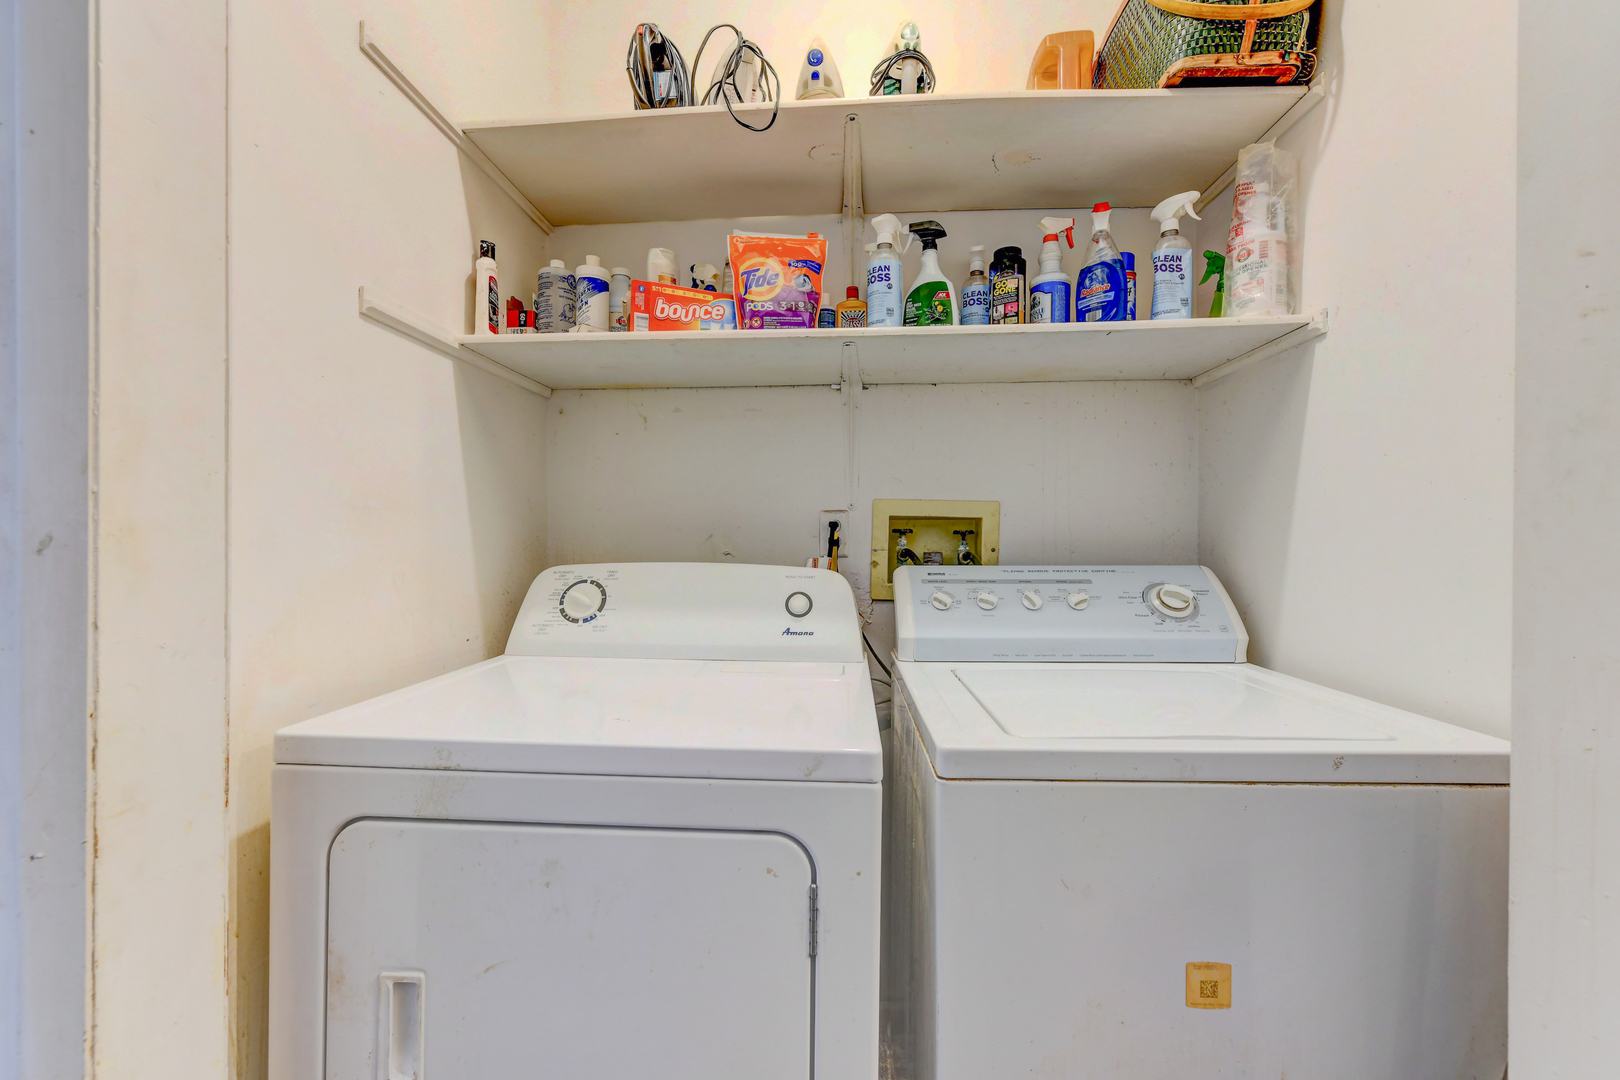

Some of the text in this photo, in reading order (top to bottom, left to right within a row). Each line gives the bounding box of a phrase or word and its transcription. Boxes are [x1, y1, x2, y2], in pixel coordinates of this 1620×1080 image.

[1153, 254, 1182, 264] CLEAN
[1154, 264, 1183, 274] BOSS
[740, 267, 780, 297] Tide
[962, 290, 988, 299] CLEAN
[994, 287, 1018, 296] GONE
[746, 302, 774, 312] PODS
[962, 298, 988, 308] BOSS
[655, 298, 725, 322] bounce
[782, 627, 814, 636] Amana
